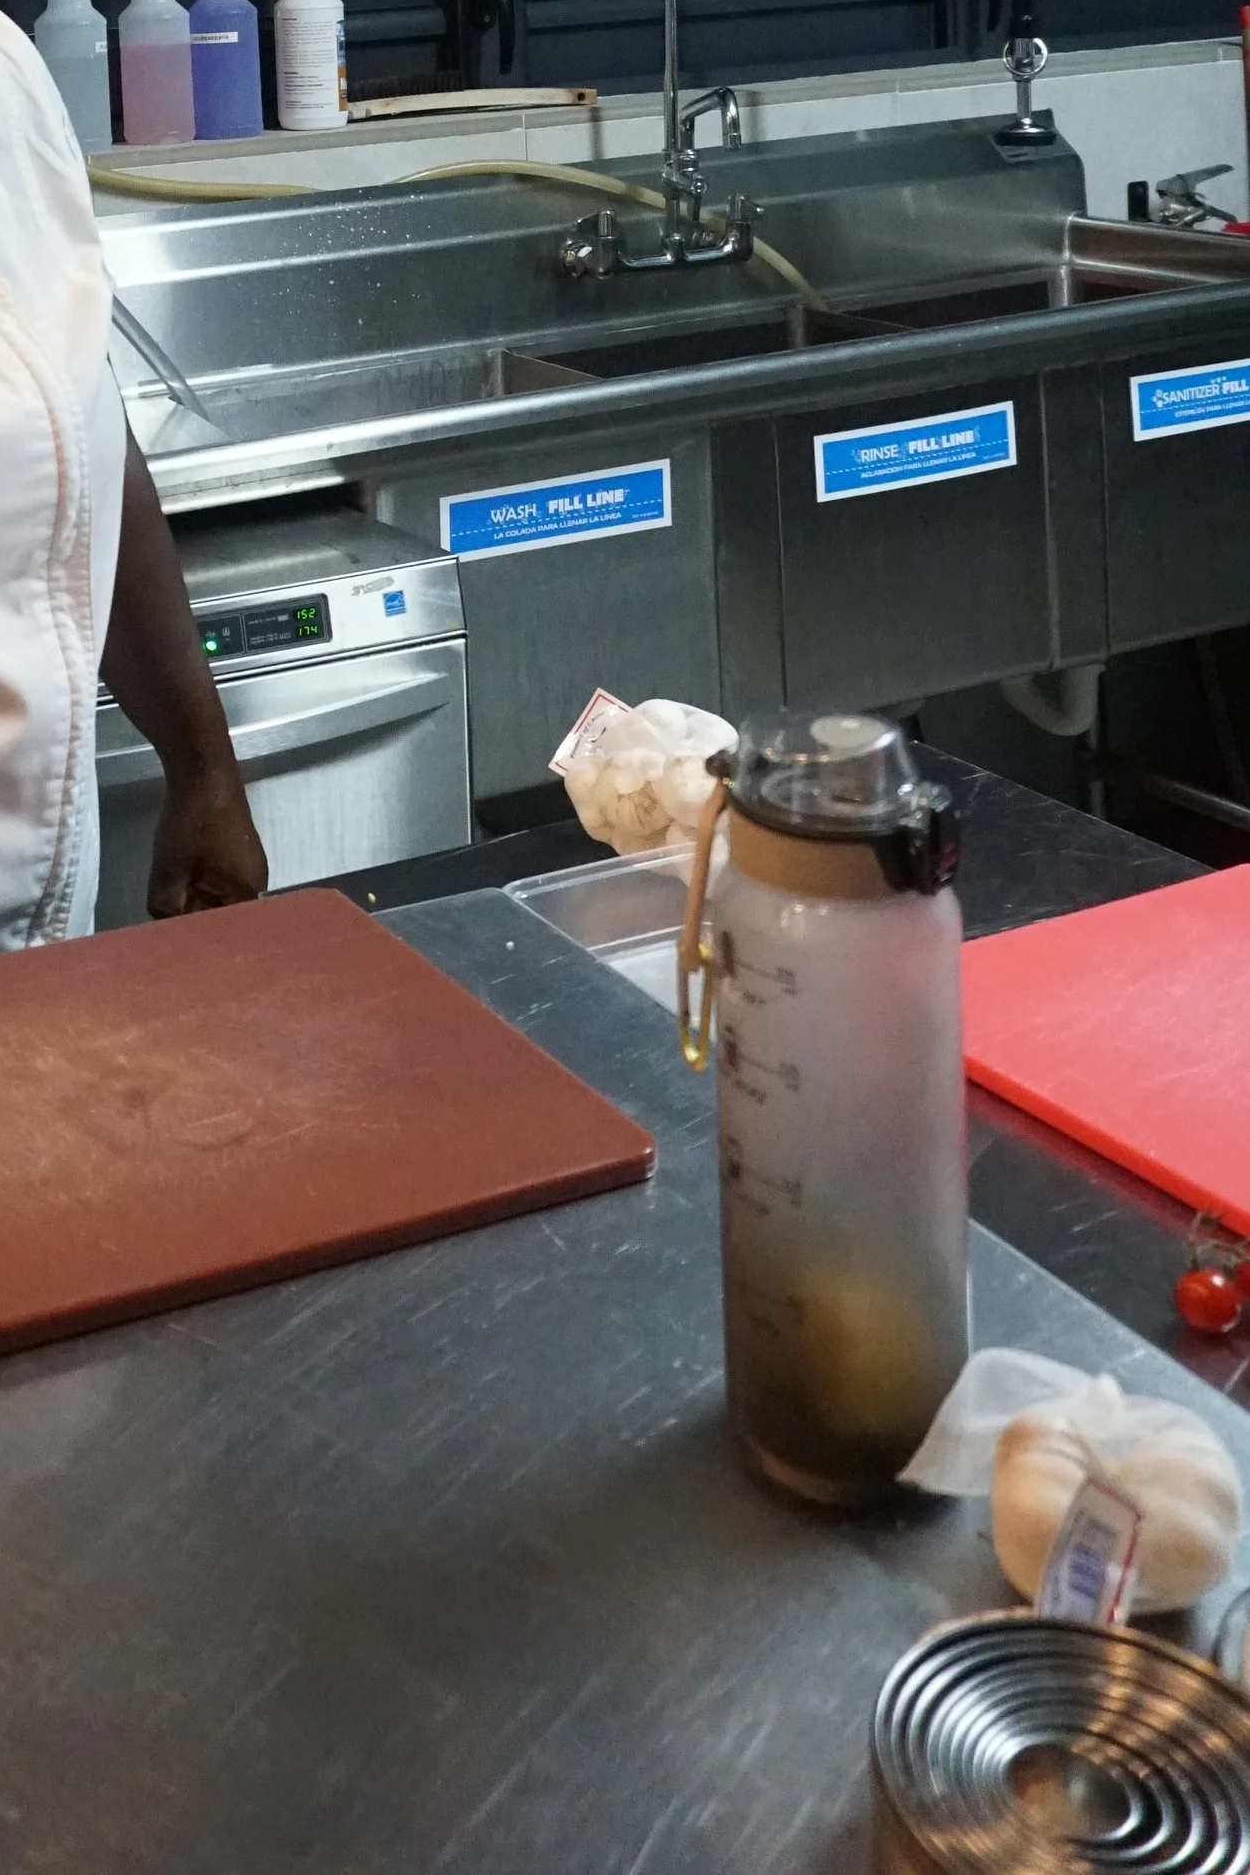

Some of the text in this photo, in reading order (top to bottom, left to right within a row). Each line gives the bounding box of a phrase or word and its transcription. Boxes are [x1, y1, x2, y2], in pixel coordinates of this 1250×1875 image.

[1163, 379, 1249, 404] SANITIZER FILL
[860, 430, 975, 463] RINSE FILL LINE
[903, 462, 922, 470] PARA
[948, 455, 957, 463] LA
[491, 488, 624, 523] WASH FILL LINE
[494, 532, 504, 540] LA
[505, 526, 537, 537] COLADA
[538, 523, 559, 531] PARA
[559, 518, 588, 528] LLENAR
[589, 515, 599, 523] LA
[297, 608, 316, 620] 152
[299, 625, 318, 636] 174
